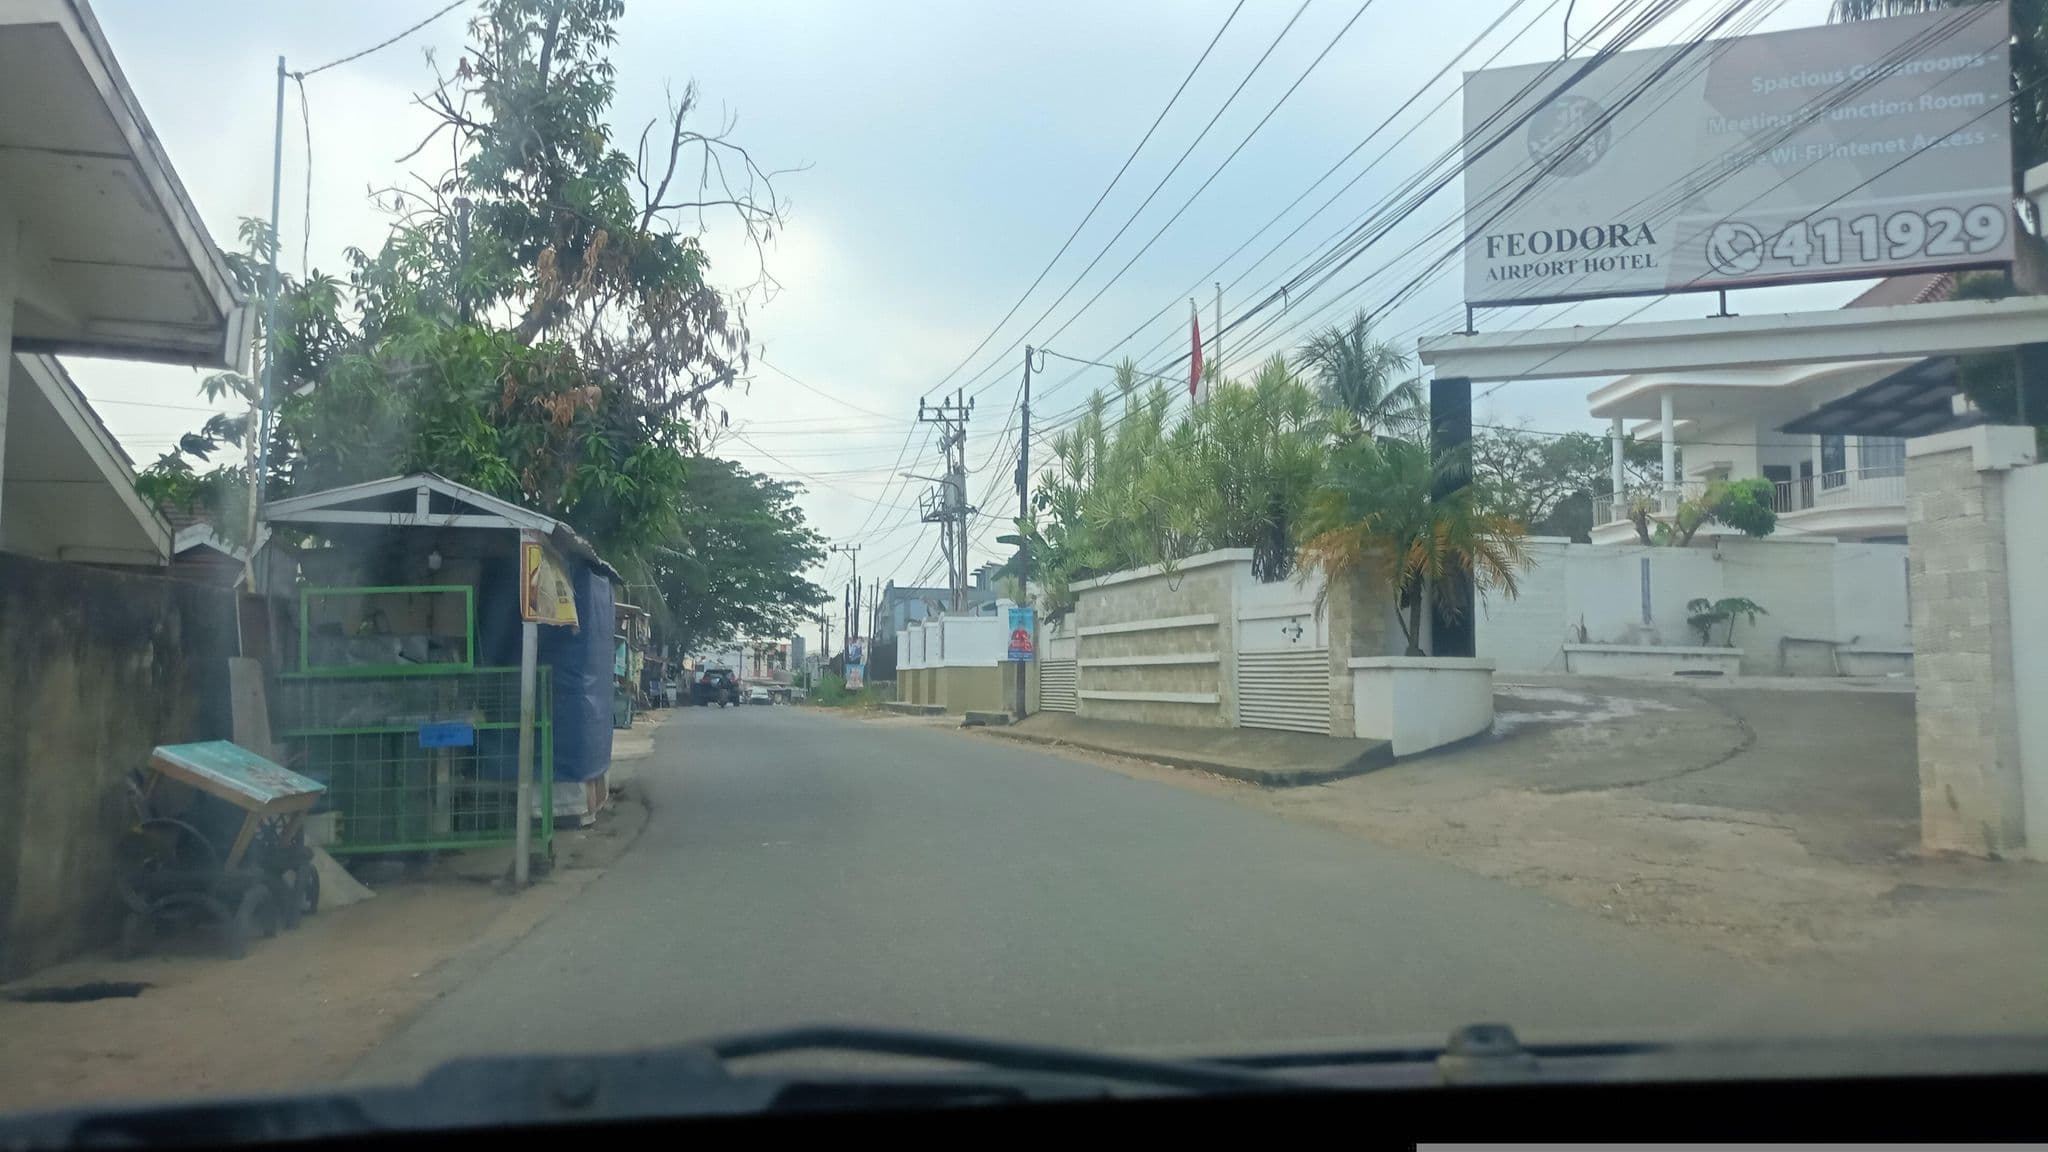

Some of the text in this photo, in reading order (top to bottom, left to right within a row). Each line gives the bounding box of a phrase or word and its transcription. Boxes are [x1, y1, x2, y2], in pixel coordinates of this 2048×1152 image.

[1751, 68, 1844, 95] Spacious
[1708, 112, 1793, 134] Meeting
[1817, 101, 1913, 127] unction
[1919, 94, 1985, 111] Room
[1771, 144, 1822, 164] Wi-Fi
[1912, 131, 1985, 150] Access
[1486, 221, 1657, 259] FEODORA
[1774, 204, 2006, 267] 411929
[1486, 253, 1659, 282] AIRPORT HOTEL
